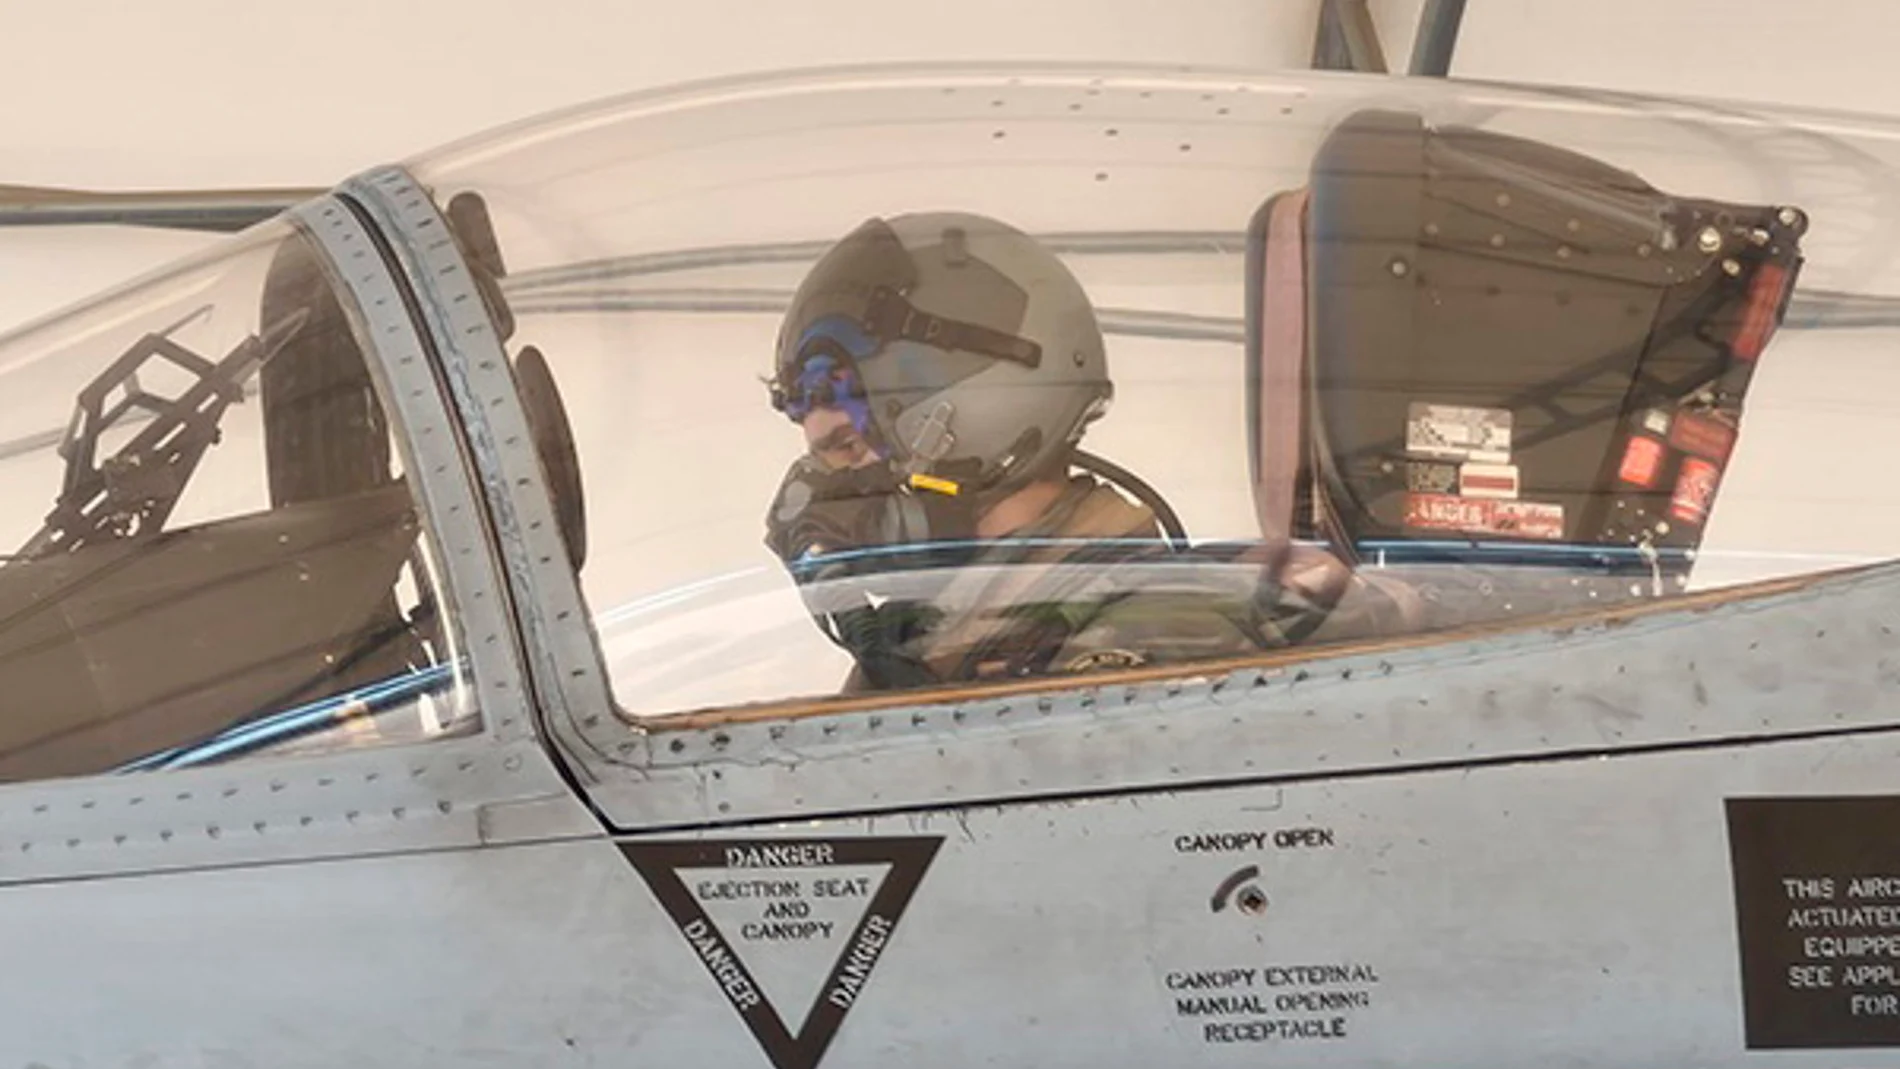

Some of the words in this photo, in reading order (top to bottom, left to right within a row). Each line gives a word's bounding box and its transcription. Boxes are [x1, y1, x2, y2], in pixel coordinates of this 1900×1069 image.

[1174, 832, 1267, 852] CANOPY
[1273, 828, 1334, 848] OPEN
[725, 844, 834, 868] DANGER
[698, 880, 800, 900] EJECTION
[813, 877, 869, 898] SEAT
[1782, 877, 1834, 899] THIS
[763, 901, 811, 919] AND
[741, 921, 834, 941] CANOPY
[1804, 936, 1900, 958] EQUIPPE
[683, 918, 760, 1012] DANGER
[828, 914, 893, 1009] DANGER
[1166, 968, 1256, 990] CANOPY
[1263, 964, 1379, 986] EXTERNAL
[1788, 965, 1833, 987] SEE
[1842, 965, 1900, 986] APPL
[1176, 995, 1267, 1016] MANUAL
[1275, 991, 1370, 1013] OPENING
[1851, 994, 1899, 1016] FOR
[1204, 1016, 1347, 1043] RECEPTACLE
